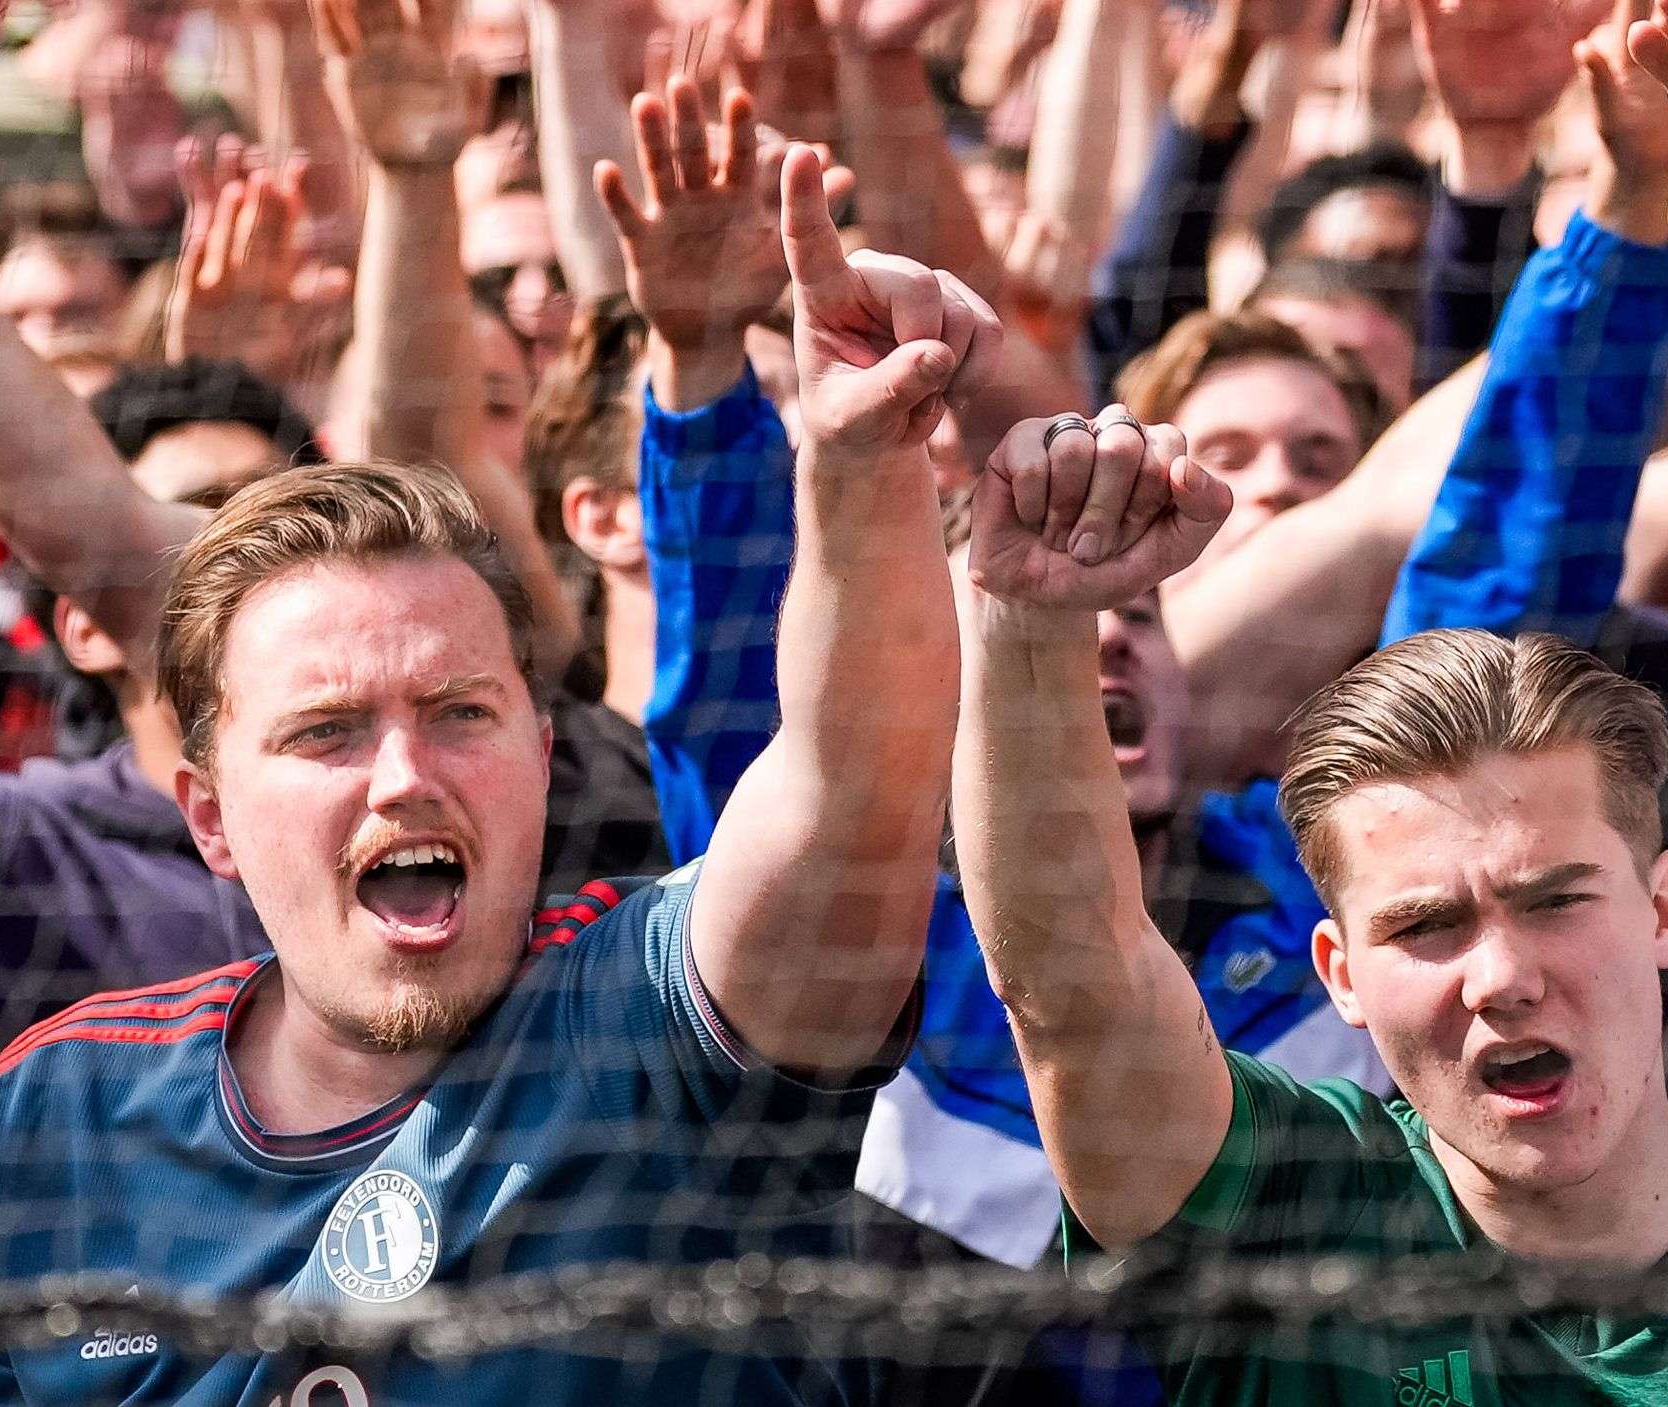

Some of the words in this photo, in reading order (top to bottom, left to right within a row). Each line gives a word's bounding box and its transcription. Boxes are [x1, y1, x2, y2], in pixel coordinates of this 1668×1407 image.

[331, 1175, 422, 1233] FEYENOORD
[334, 1241, 435, 1298] ROTTERDAM
[80, 1329, 158, 1360] adidas
